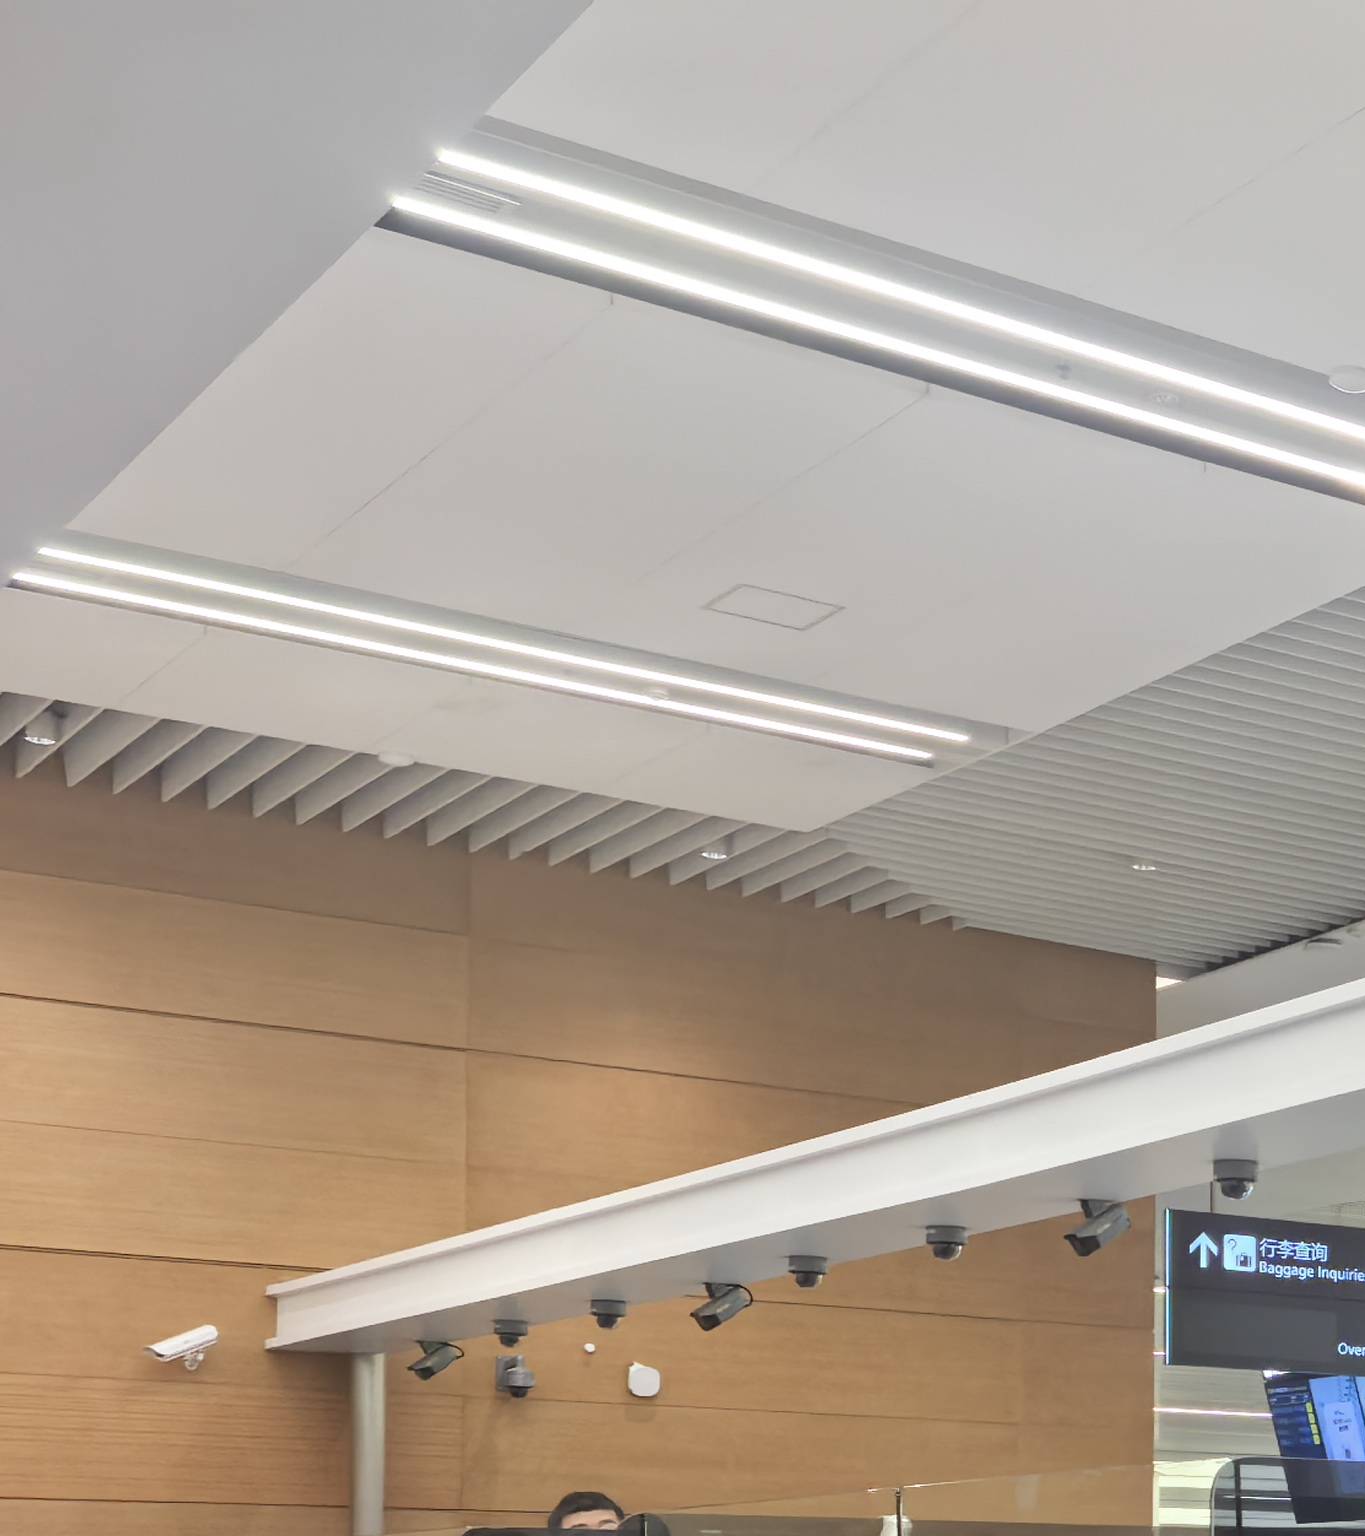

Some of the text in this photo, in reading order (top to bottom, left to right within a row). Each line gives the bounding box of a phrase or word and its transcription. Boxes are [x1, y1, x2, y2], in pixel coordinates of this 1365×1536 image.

[1260, 1238, 1328, 1262] 行李查询
[1259, 1260, 1315, 1280] Baggage
